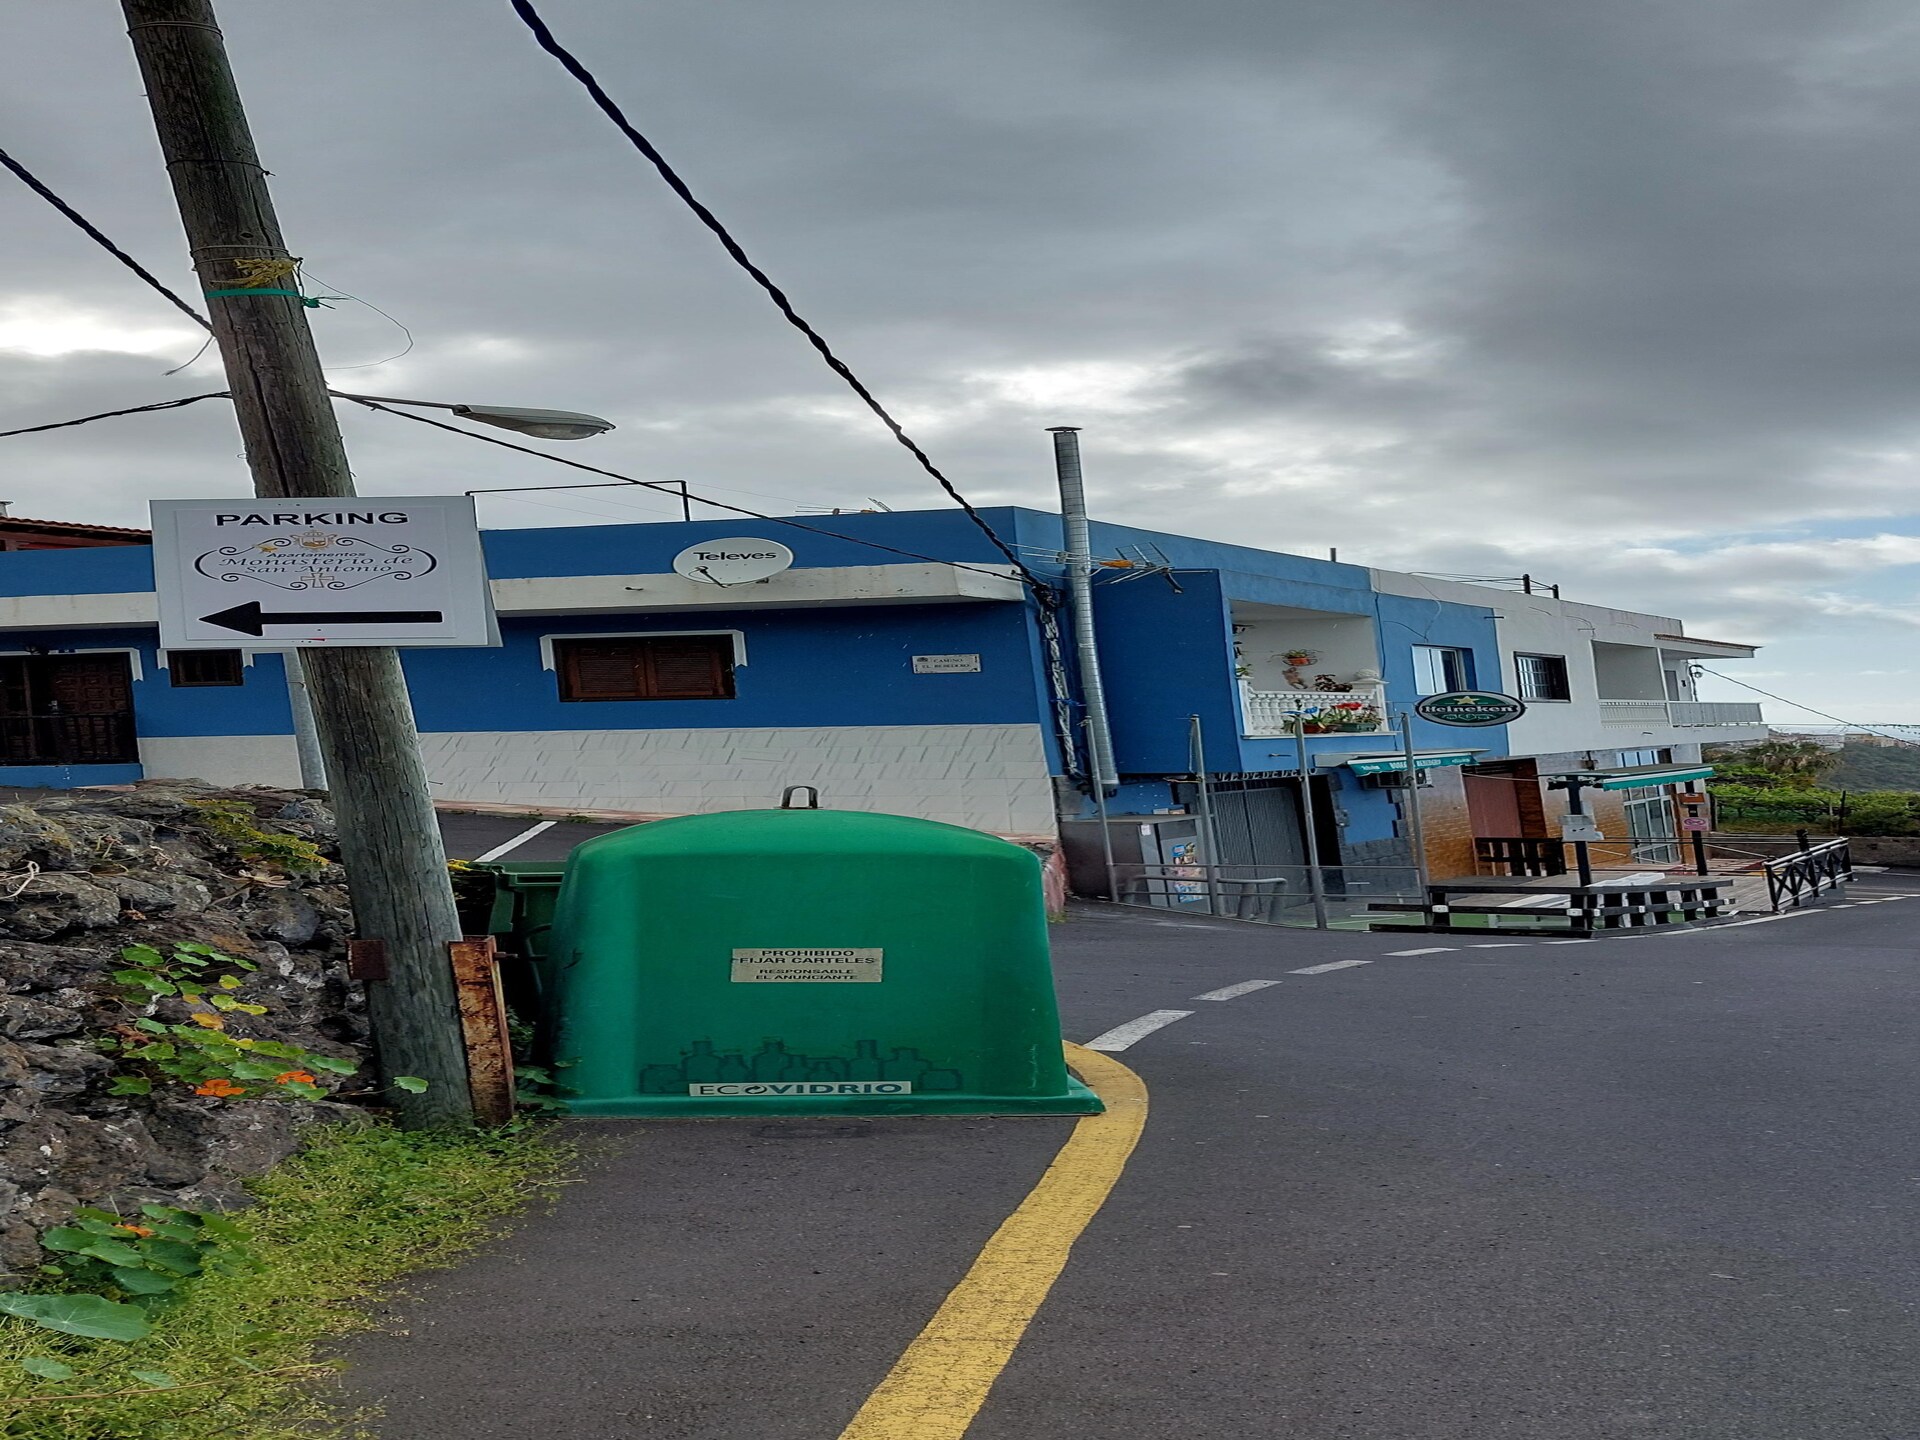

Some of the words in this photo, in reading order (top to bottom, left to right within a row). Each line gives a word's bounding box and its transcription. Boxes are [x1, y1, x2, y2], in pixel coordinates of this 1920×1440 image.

[215, 511, 409, 527] PARKING
[218, 557, 374, 567] Monasterio
[383, 555, 414, 565] de
[692, 551, 778, 561] Televes
[245, 565, 288, 574] San
[294, 565, 392, 573] Antonio
[1425, 705, 1514, 713] Heineken
[699, 1083, 903, 1096] ECOVIDRIO
